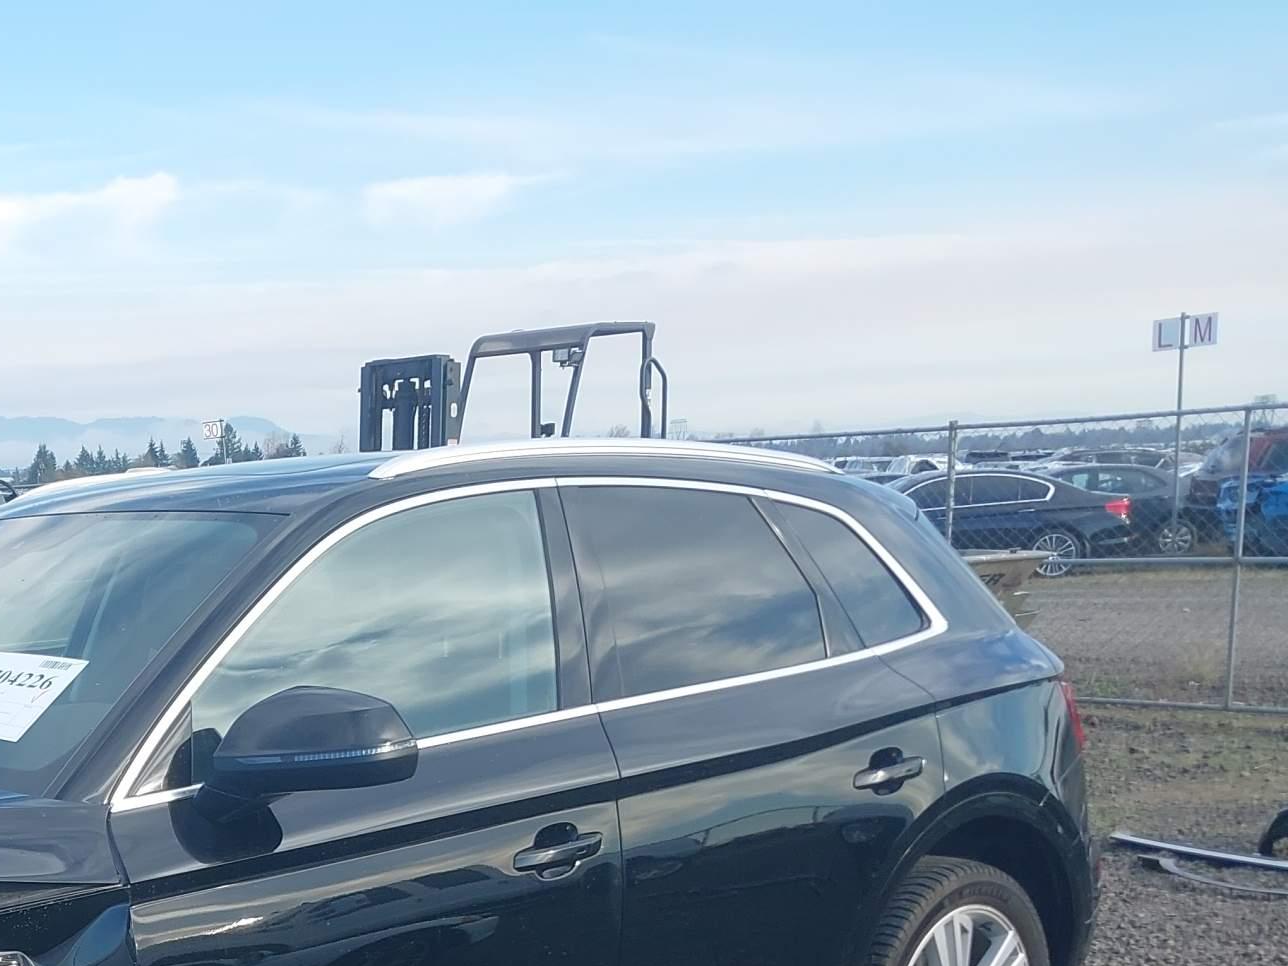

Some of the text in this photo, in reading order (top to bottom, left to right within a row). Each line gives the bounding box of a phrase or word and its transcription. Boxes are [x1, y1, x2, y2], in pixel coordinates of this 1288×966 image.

[1158, 322, 1173, 348] L
[1194, 316, 1212, 344] M
[204, 423, 219, 438] 30
